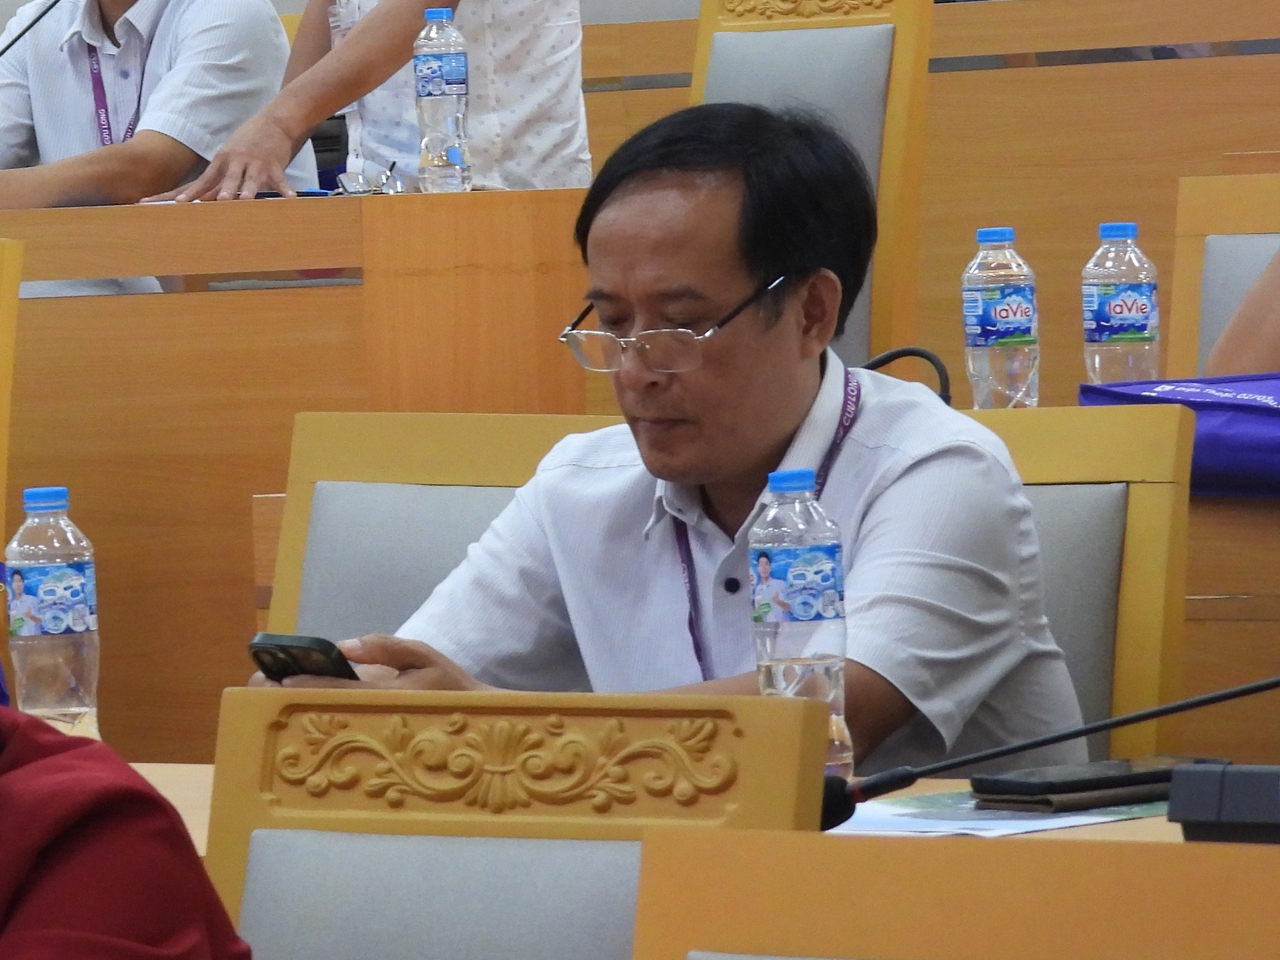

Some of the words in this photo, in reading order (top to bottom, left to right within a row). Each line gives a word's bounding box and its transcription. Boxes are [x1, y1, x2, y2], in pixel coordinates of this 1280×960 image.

[98, 108, 109, 130] LONG
[102, 129, 112, 145] CUU
[994, 302, 1031, 320] laVie
[1108, 298, 1149, 316] laVie
[842, 401, 856, 426] CUU
